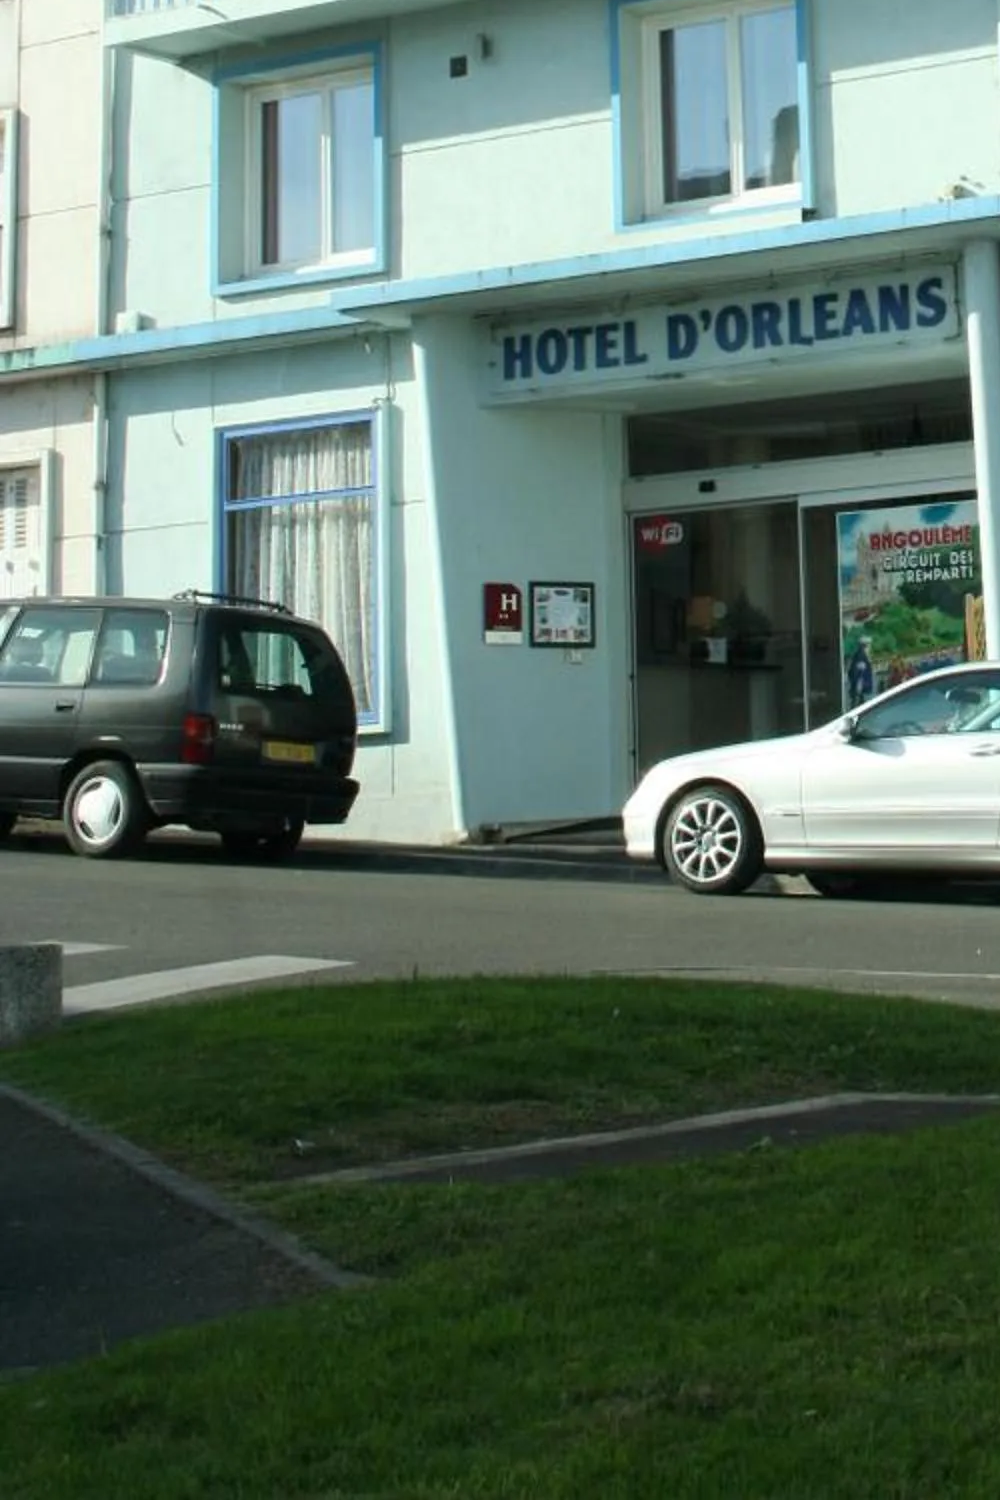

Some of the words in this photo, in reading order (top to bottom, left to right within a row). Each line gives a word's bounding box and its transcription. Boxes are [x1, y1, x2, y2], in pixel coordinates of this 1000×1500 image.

[503, 321, 648, 380] HOTEL
[667, 277, 948, 361] D'ORLEANS
[883, 552, 941, 571] CIRCUIT
[501, 593, 517, 611] H
